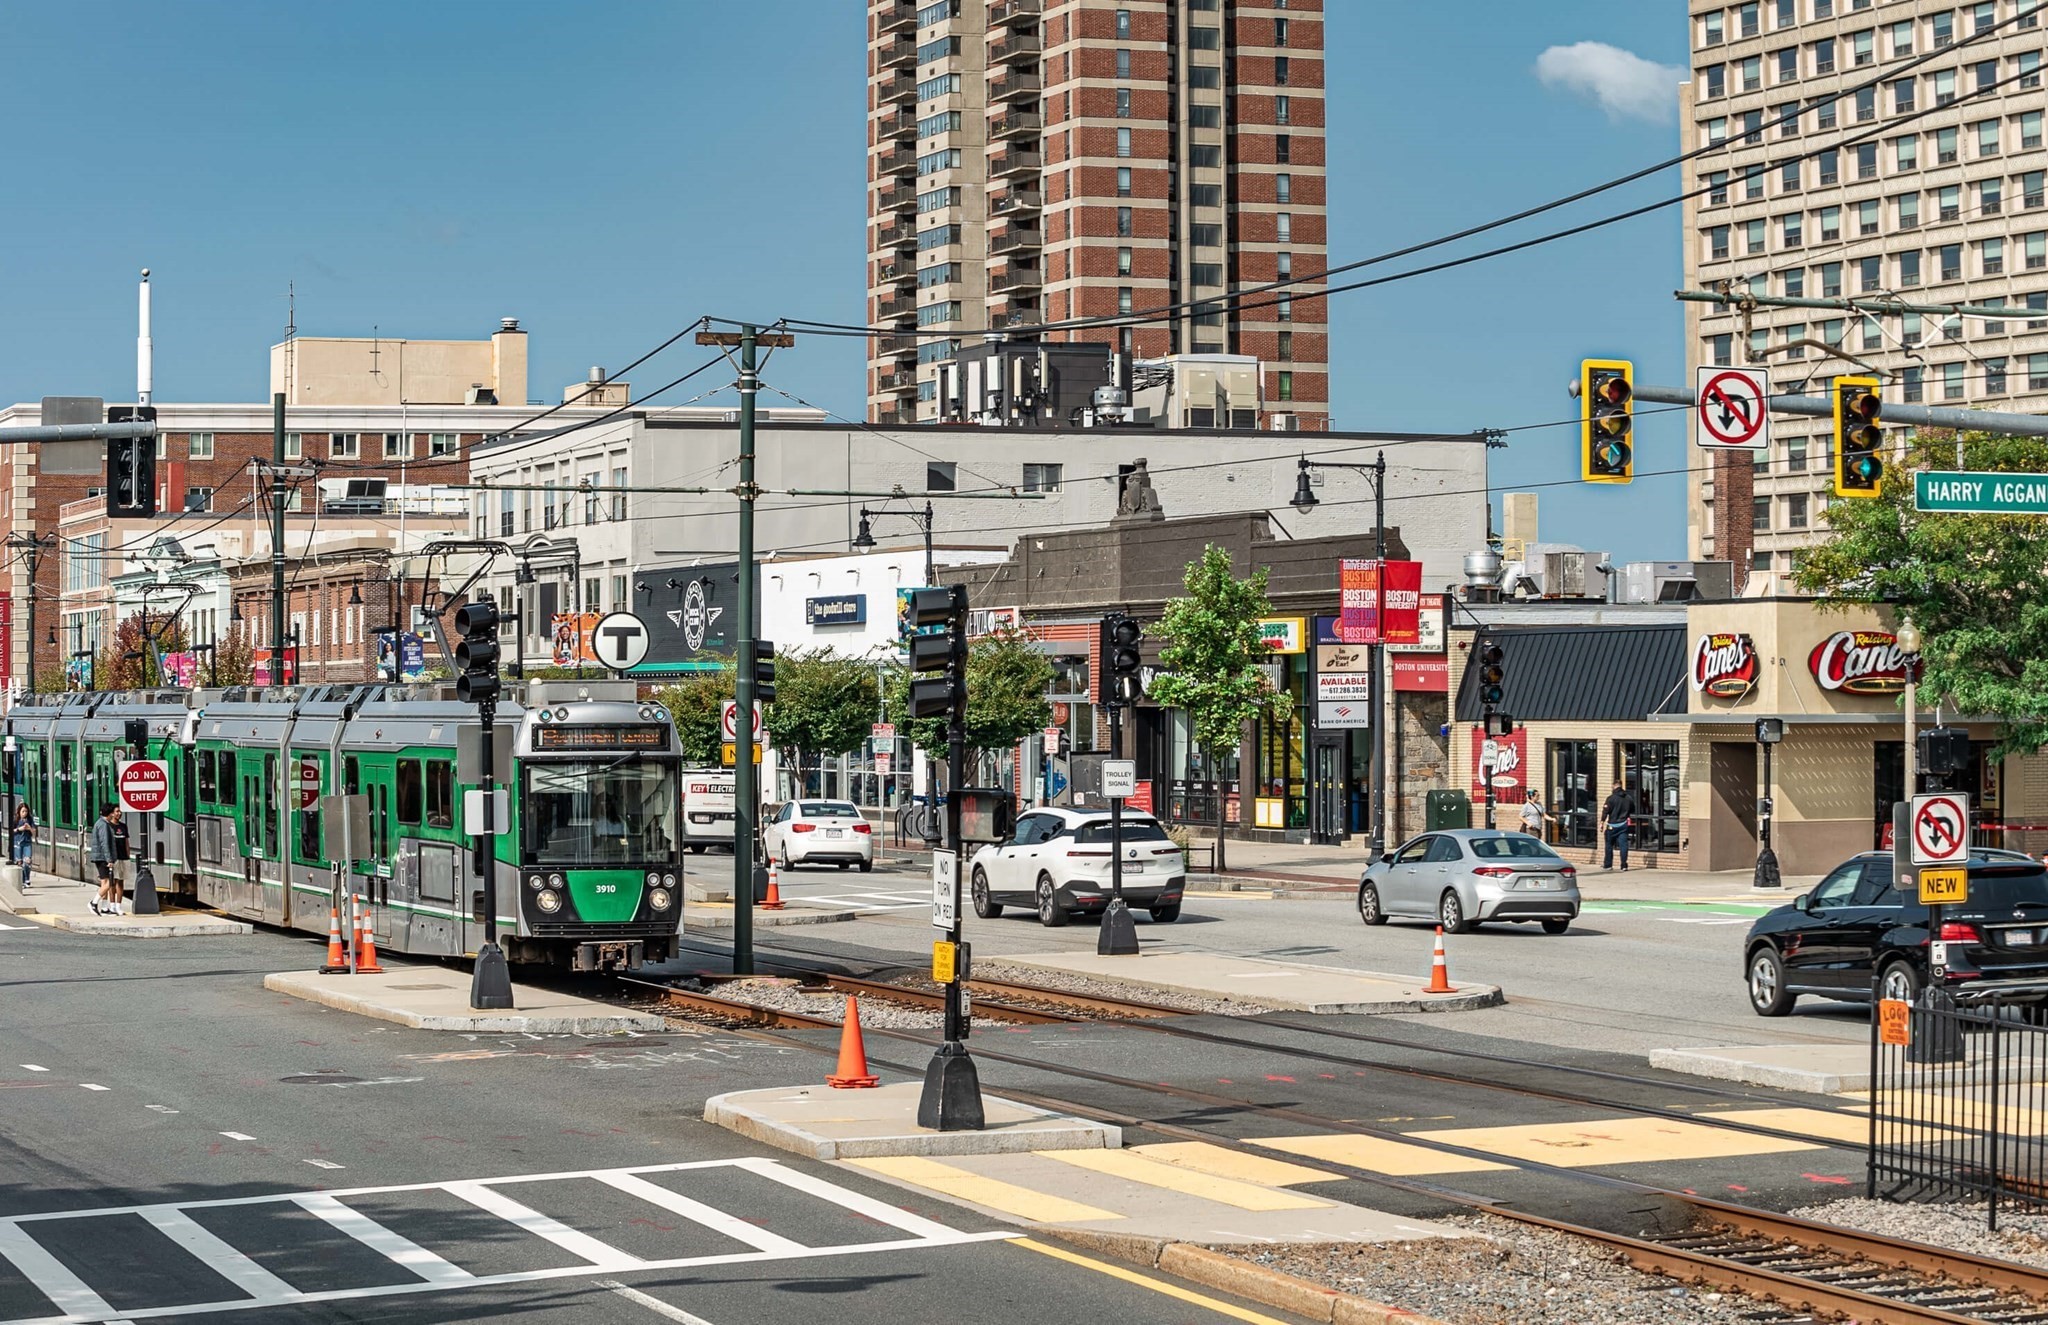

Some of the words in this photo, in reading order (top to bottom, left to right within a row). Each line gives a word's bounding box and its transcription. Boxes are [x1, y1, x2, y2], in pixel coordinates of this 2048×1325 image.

[1928, 481, 1983, 502] HARRY
[1993, 483, 2048, 503] AGGAN
[1343, 562, 1377, 570] UNIVERSITY
[1343, 570, 1377, 582] BOSTON
[1343, 581, 1377, 589] UNIVERSITY
[1343, 589, 1377, 600] BOSTON
[1385, 590, 1419, 602] BOSTON
[1343, 600, 1377, 608] UNIVERSITY
[1385, 602, 1417, 610] UNIVERSITY
[823, 602, 843, 618] goodwill
[843, 602, 857, 613] store
[1343, 608, 1377, 619] BOSTON
[1343, 627, 1377, 638] BOSTON
[603, 627, 641, 661] T
[1712, 635, 1733, 648] Raising
[1856, 633, 1893, 646] Raising
[1692, 634, 1747, 692] Cane's
[1819, 631, 1922, 690] Cane
[1395, 663, 1415, 671] BOSTON
[1417, 663, 1448, 672] UNIVERSITY
[1320, 678, 1366, 686] AVAILABLE
[127, 771, 139, 780] DO
[143, 770, 161, 779] NOT
[711, 784, 736, 793] ELECTRI
[130, 793, 158, 802] ENTER
[939, 859, 949, 876] NO
[596, 885, 616, 893] 3910
[937, 881, 951, 898] TURN
[1926, 878, 1957, 894] NEW
[934, 903, 942, 917] ON
[943, 903, 952, 920] RED
